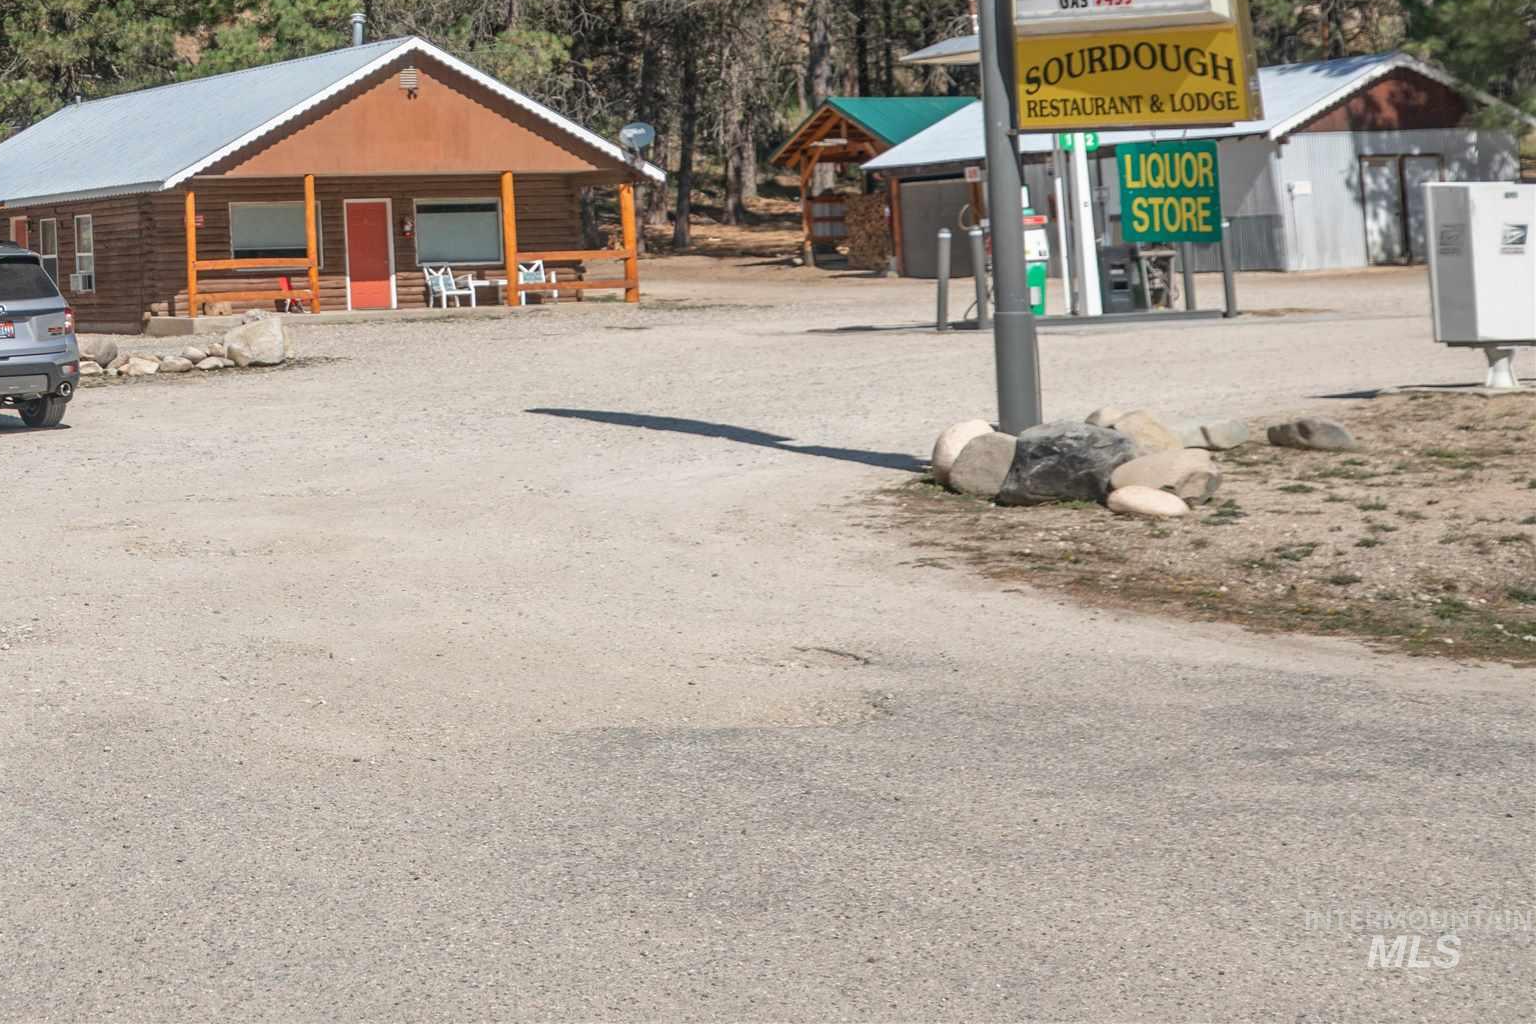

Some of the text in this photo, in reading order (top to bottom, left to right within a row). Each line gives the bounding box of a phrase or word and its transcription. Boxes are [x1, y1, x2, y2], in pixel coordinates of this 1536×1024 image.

[1024, 42, 1237, 95] SOURDOUGH
[1027, 91, 1239, 118] RESTAURANT & LODGE
[1085, 133, 1095, 146] 2
[1124, 151, 1214, 189] LIQUOR
[1132, 196, 1213, 233] STORE
